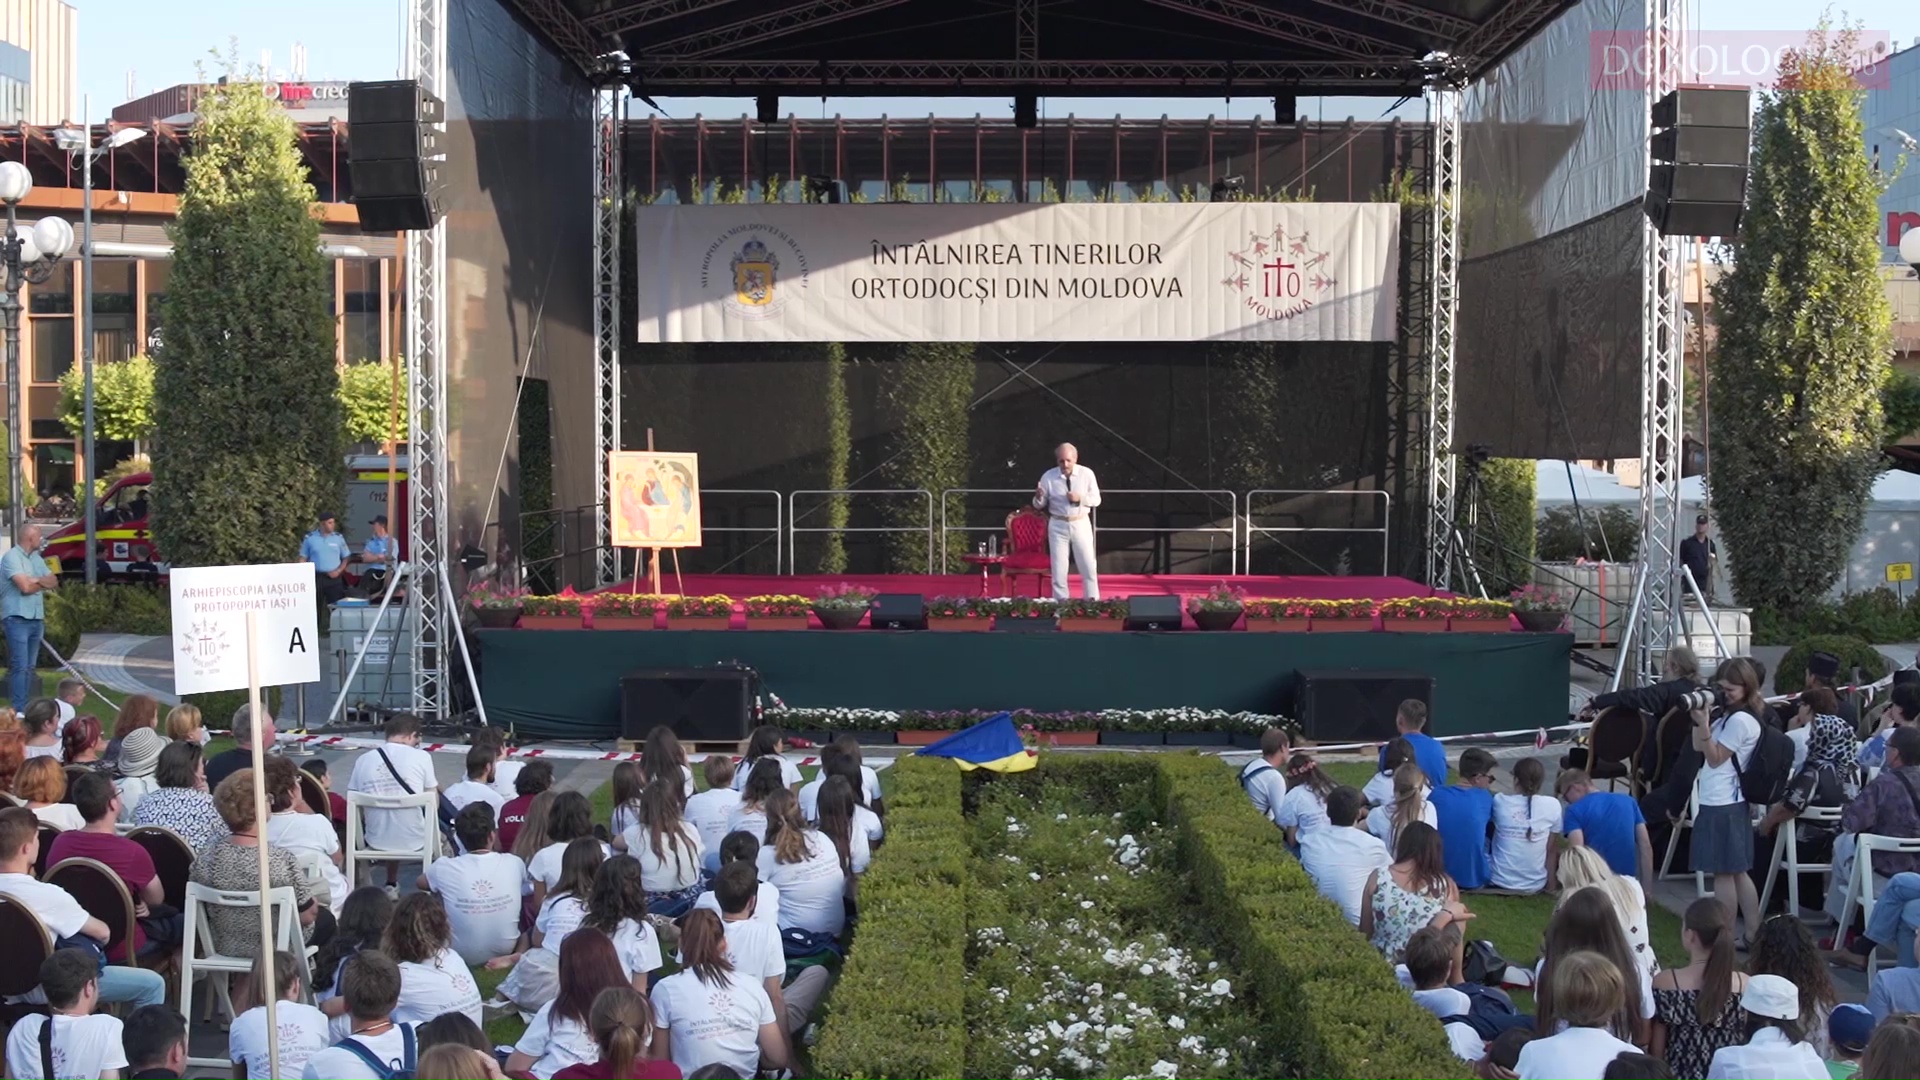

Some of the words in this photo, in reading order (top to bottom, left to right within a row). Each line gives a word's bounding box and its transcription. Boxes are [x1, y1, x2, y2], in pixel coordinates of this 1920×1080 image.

[870, 239, 1023, 266] ÎNTÂLNIREA
[1030, 243, 1163, 266] TINERILOR
[850, 277, 997, 305] ORTODOCȘI
[1006, 277, 1049, 299] DIN
[1058, 277, 1184, 299] MOLDOVA
[1244, 296, 1313, 321] MOLDOVA
[182, 585, 263, 599] ARHIEPISCOPIA
[194, 599, 267, 613] PROTOPOPIAT
[289, 627, 306, 654] A
